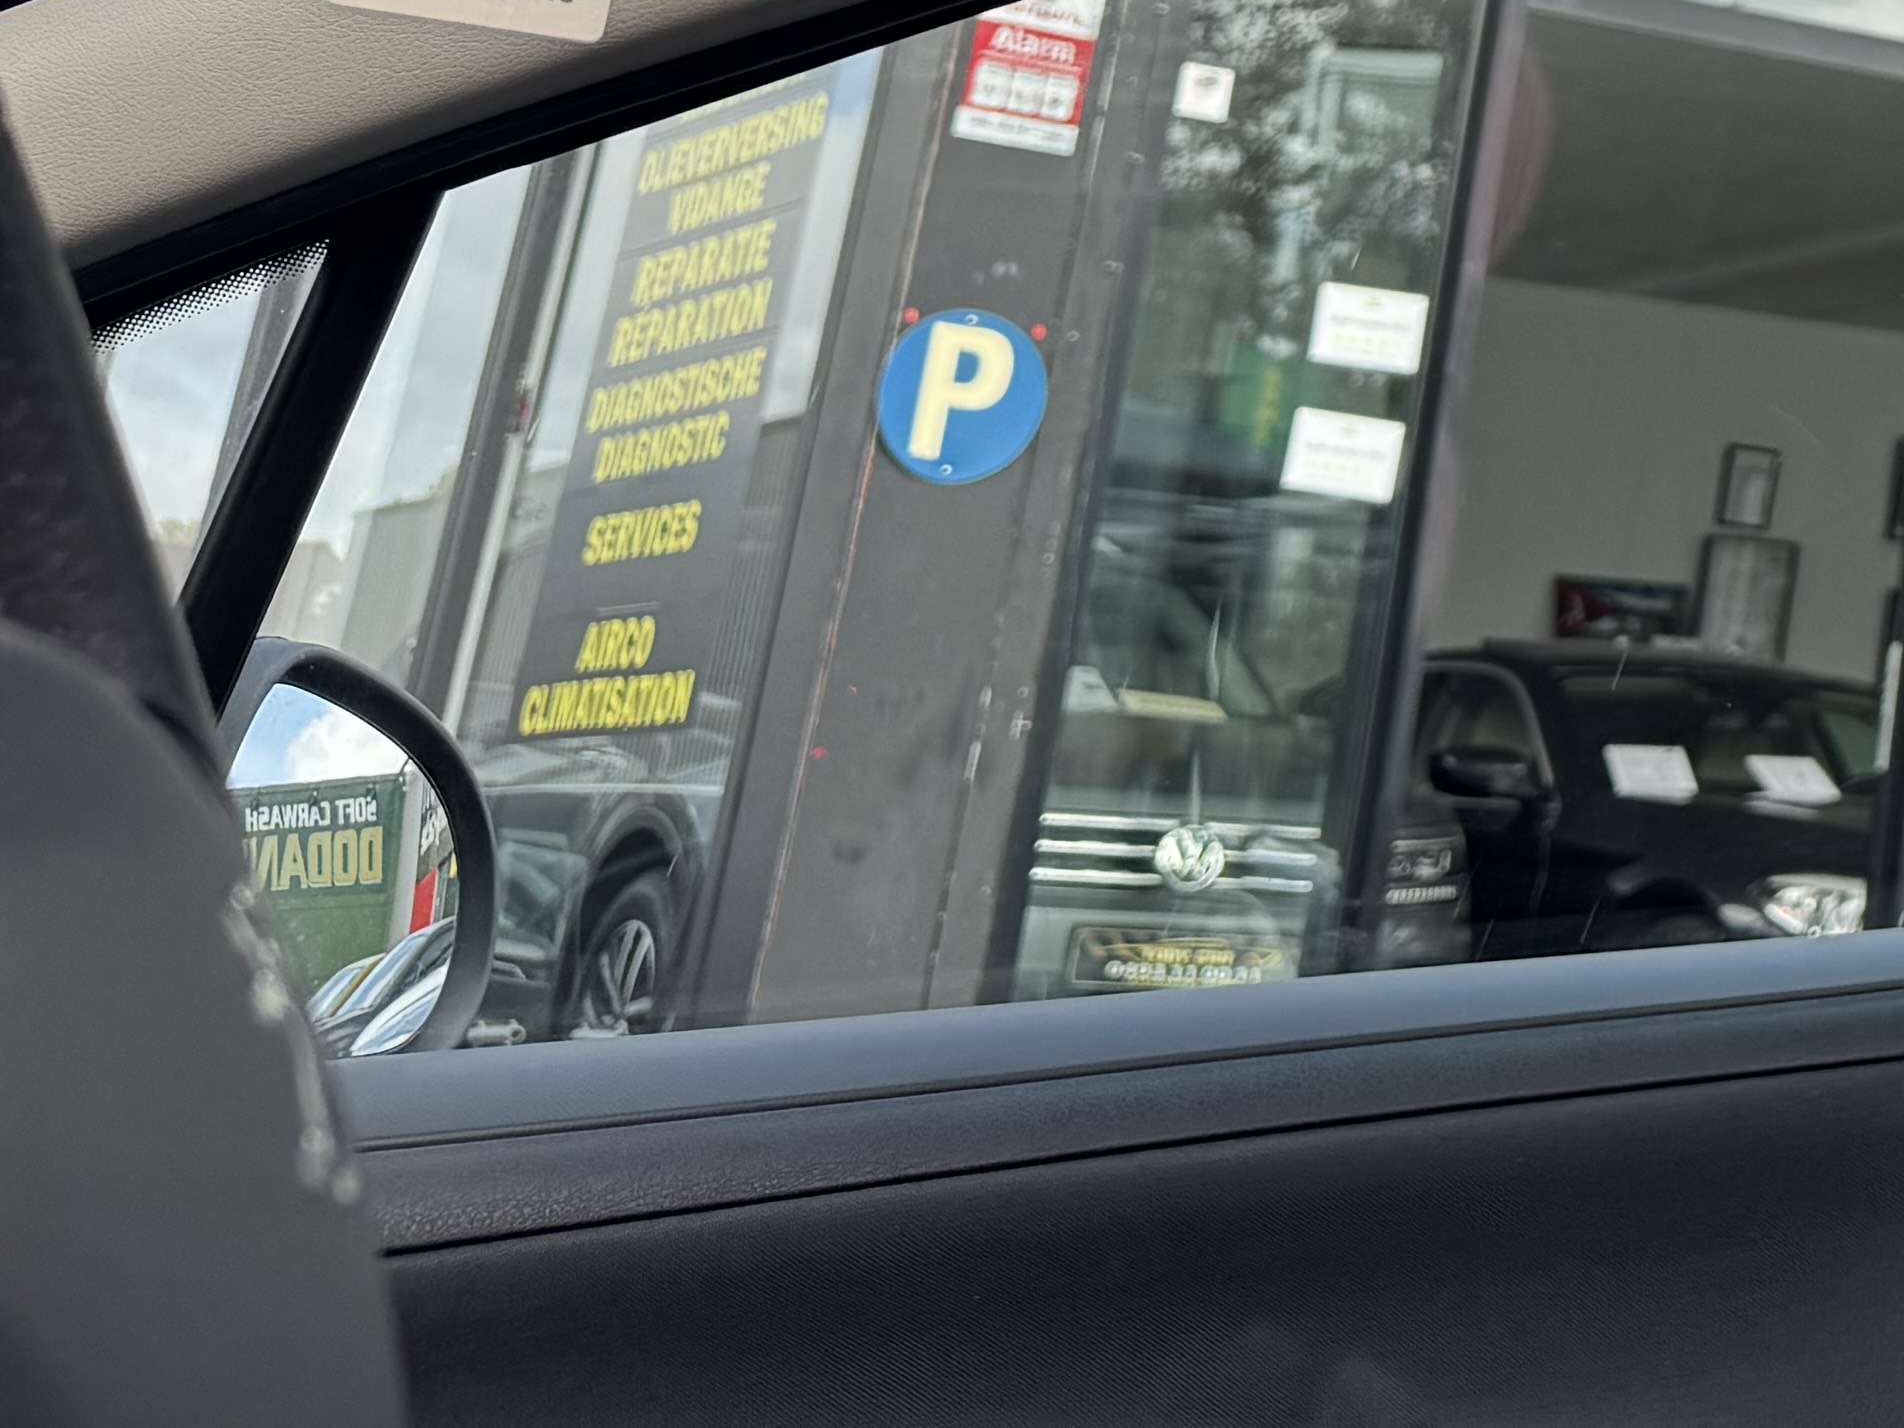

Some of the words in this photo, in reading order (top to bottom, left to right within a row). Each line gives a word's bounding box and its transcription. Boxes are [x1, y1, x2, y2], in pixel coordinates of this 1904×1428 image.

[666, 160, 772, 234] VIDANGE
[629, 216, 777, 308] REPARATIE
[585, 345, 768, 434] DIAGNOSTISCHE
[907, 320, 1015, 462] P
[594, 409, 731, 485] DIAGNOSTIC
[581, 497, 703, 568] SERVICES
[574, 615, 657, 674] AIRCO
[518, 667, 697, 737] CLIMATISATION
